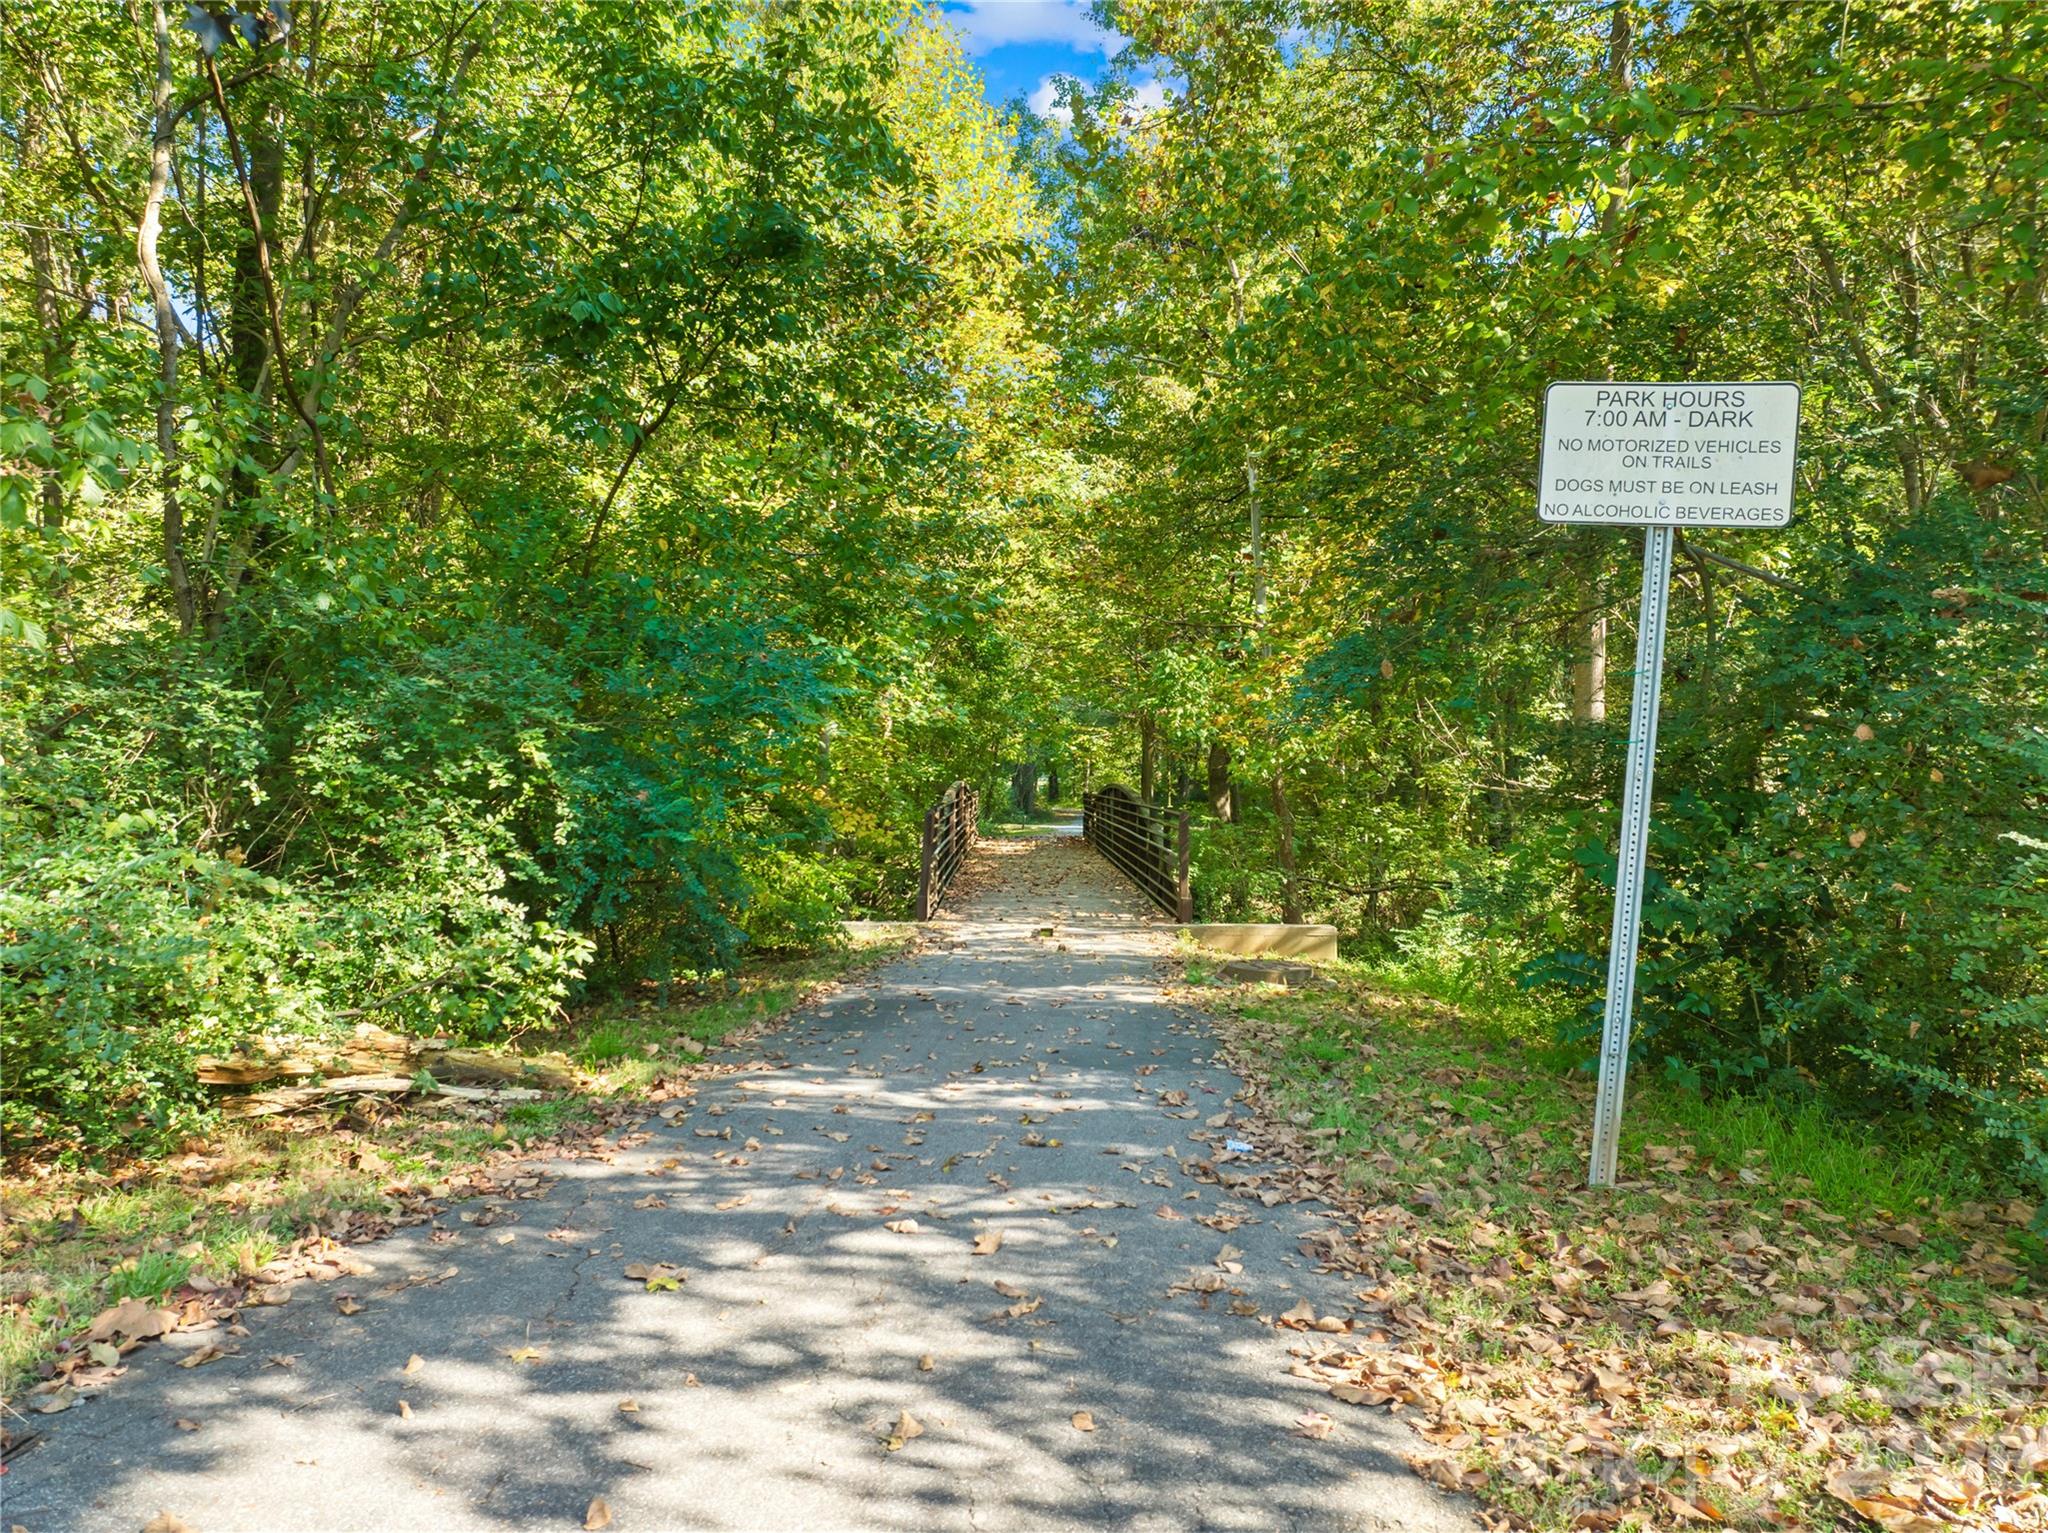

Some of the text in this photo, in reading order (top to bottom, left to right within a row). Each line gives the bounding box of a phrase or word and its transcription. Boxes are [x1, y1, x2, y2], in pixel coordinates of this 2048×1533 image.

[1597, 390, 1746, 408] PARK HOURS
[1585, 410, 1627, 427] 7:00
[1632, 410, 1668, 427] AM
[1689, 411, 1754, 427] DARK
[1558, 438, 1781, 455] NO MOTORIZED VEHICLES
[1622, 455, 1712, 469] ON TRAILS
[1555, 479, 1777, 495] DOGS MUST BE ON LEASH
[1545, 503, 1784, 522] NO ALCOHOLIC BEVERAGES
